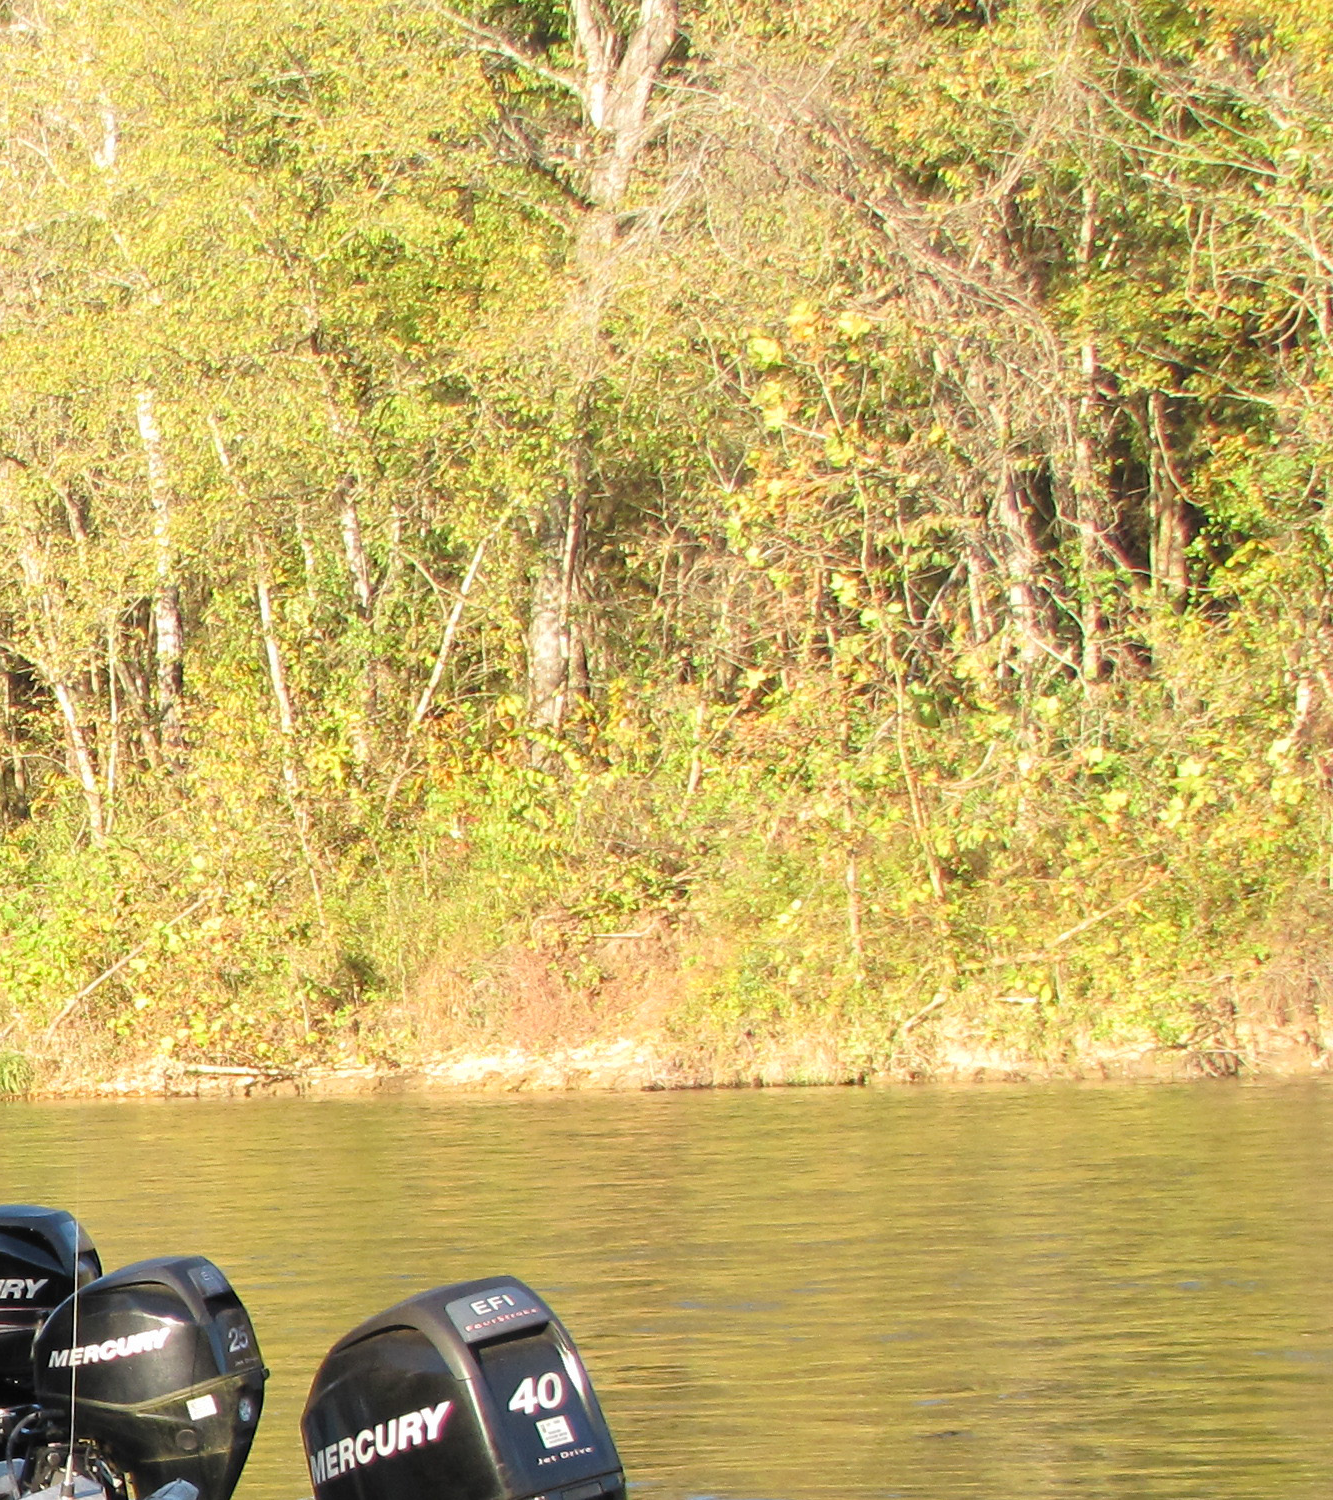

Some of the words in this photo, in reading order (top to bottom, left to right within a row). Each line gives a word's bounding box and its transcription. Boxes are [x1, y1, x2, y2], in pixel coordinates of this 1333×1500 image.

[469, 1294, 516, 1317] EFI
[48, 1327, 171, 1369] MERCURY
[227, 1325, 249, 1353] 25
[508, 1371, 565, 1415] 40
[309, 1400, 452, 1485] MERCURY
[559, 1446, 594, 1460] Drive
